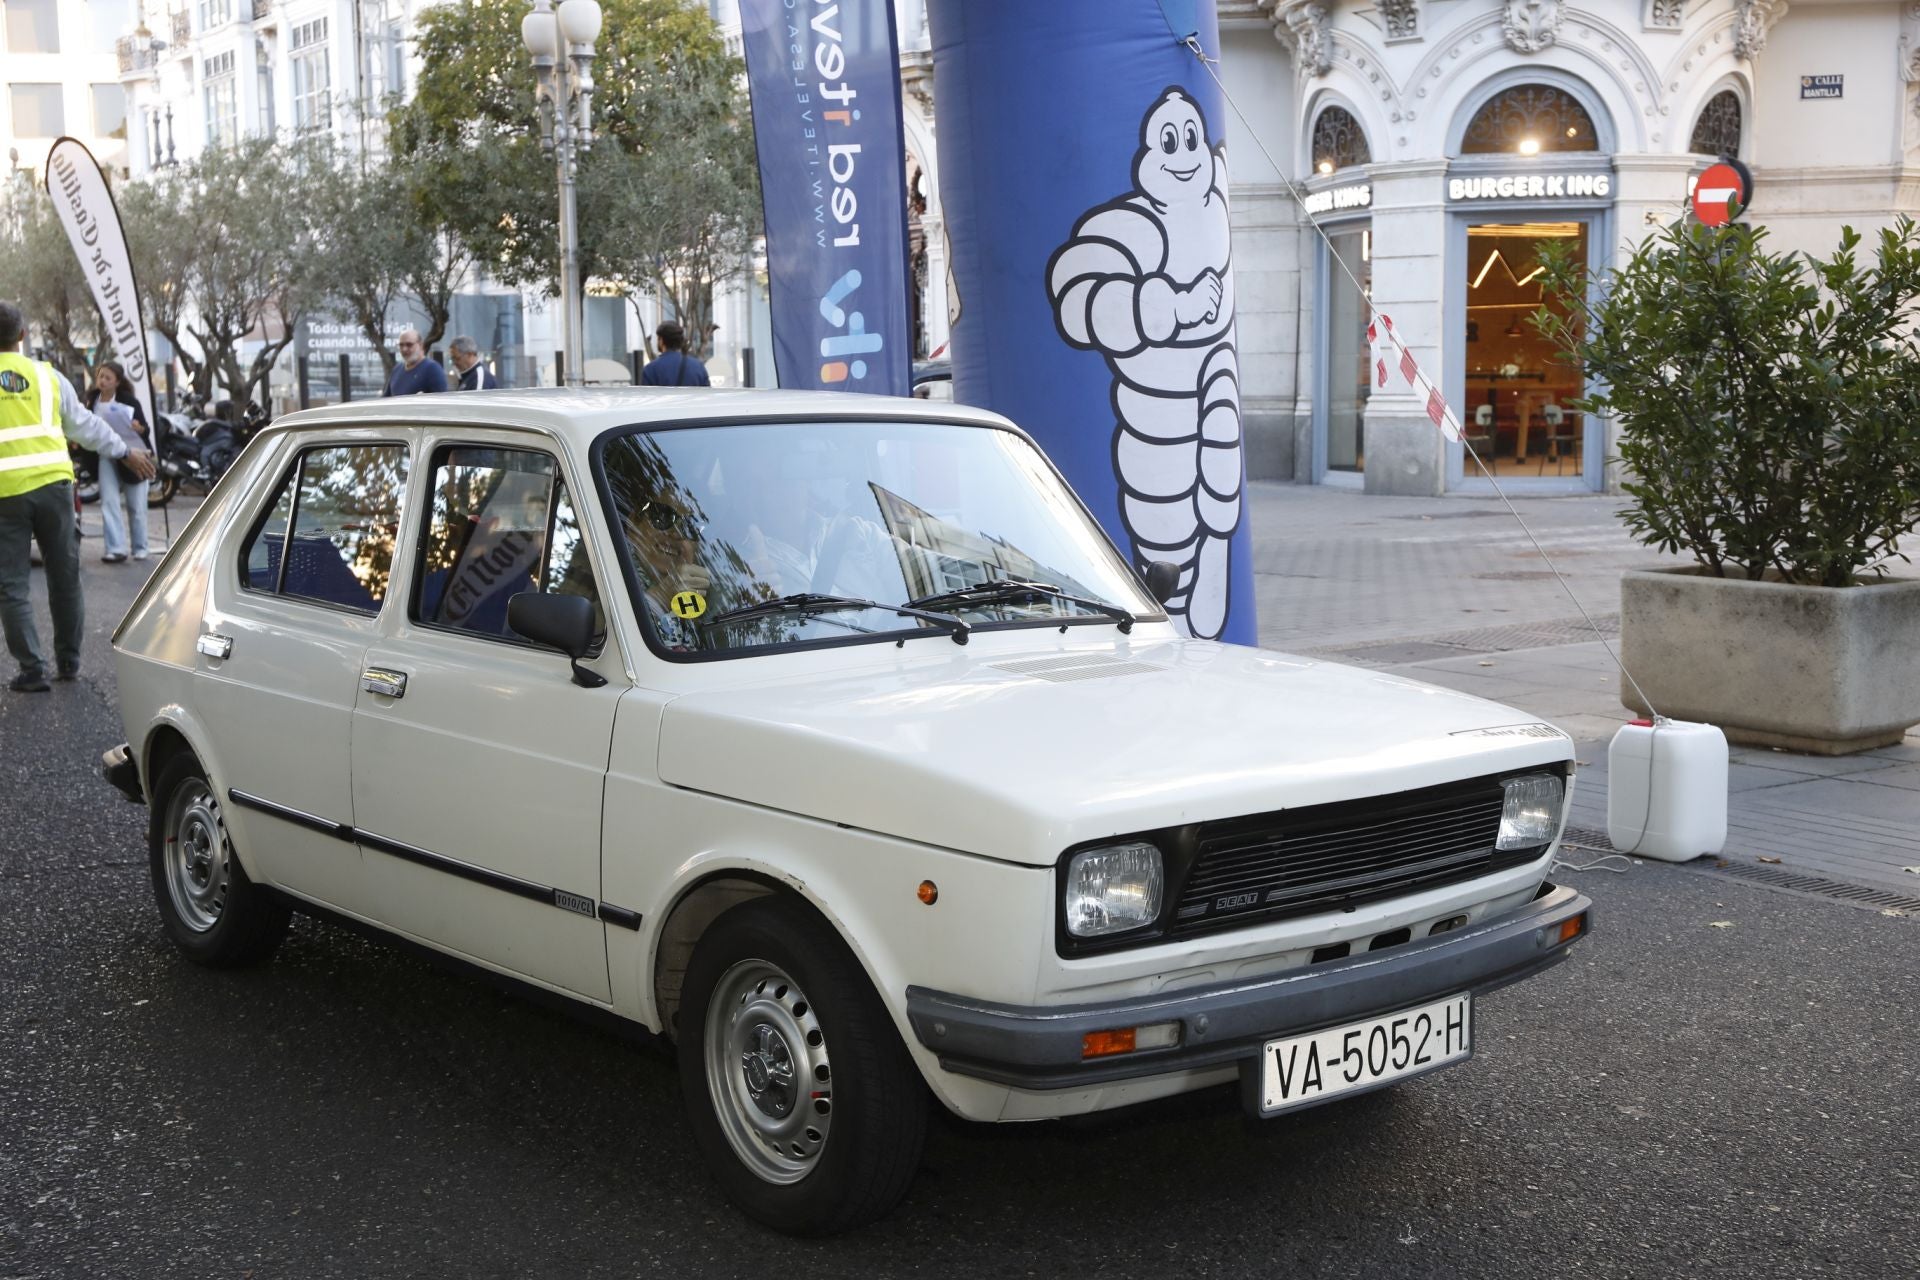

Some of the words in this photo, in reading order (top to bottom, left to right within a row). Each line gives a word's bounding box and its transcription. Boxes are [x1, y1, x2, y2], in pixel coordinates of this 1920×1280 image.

[1815, 76, 1841, 86] CALLE
[1803, 87, 1840, 98] MANTILLA
[1449, 175, 1545, 200] BURGER
[1546, 174, 1610, 197] KING
[307, 322, 339, 335] Todo
[308, 336, 355, 348] cuando
[308, 350, 321, 361] el
[323, 351, 362, 361] mimo
[678, 595, 699, 614] H
[557, 894, 591, 913] 1010/CL
[1216, 892, 1258, 910] SEAT
